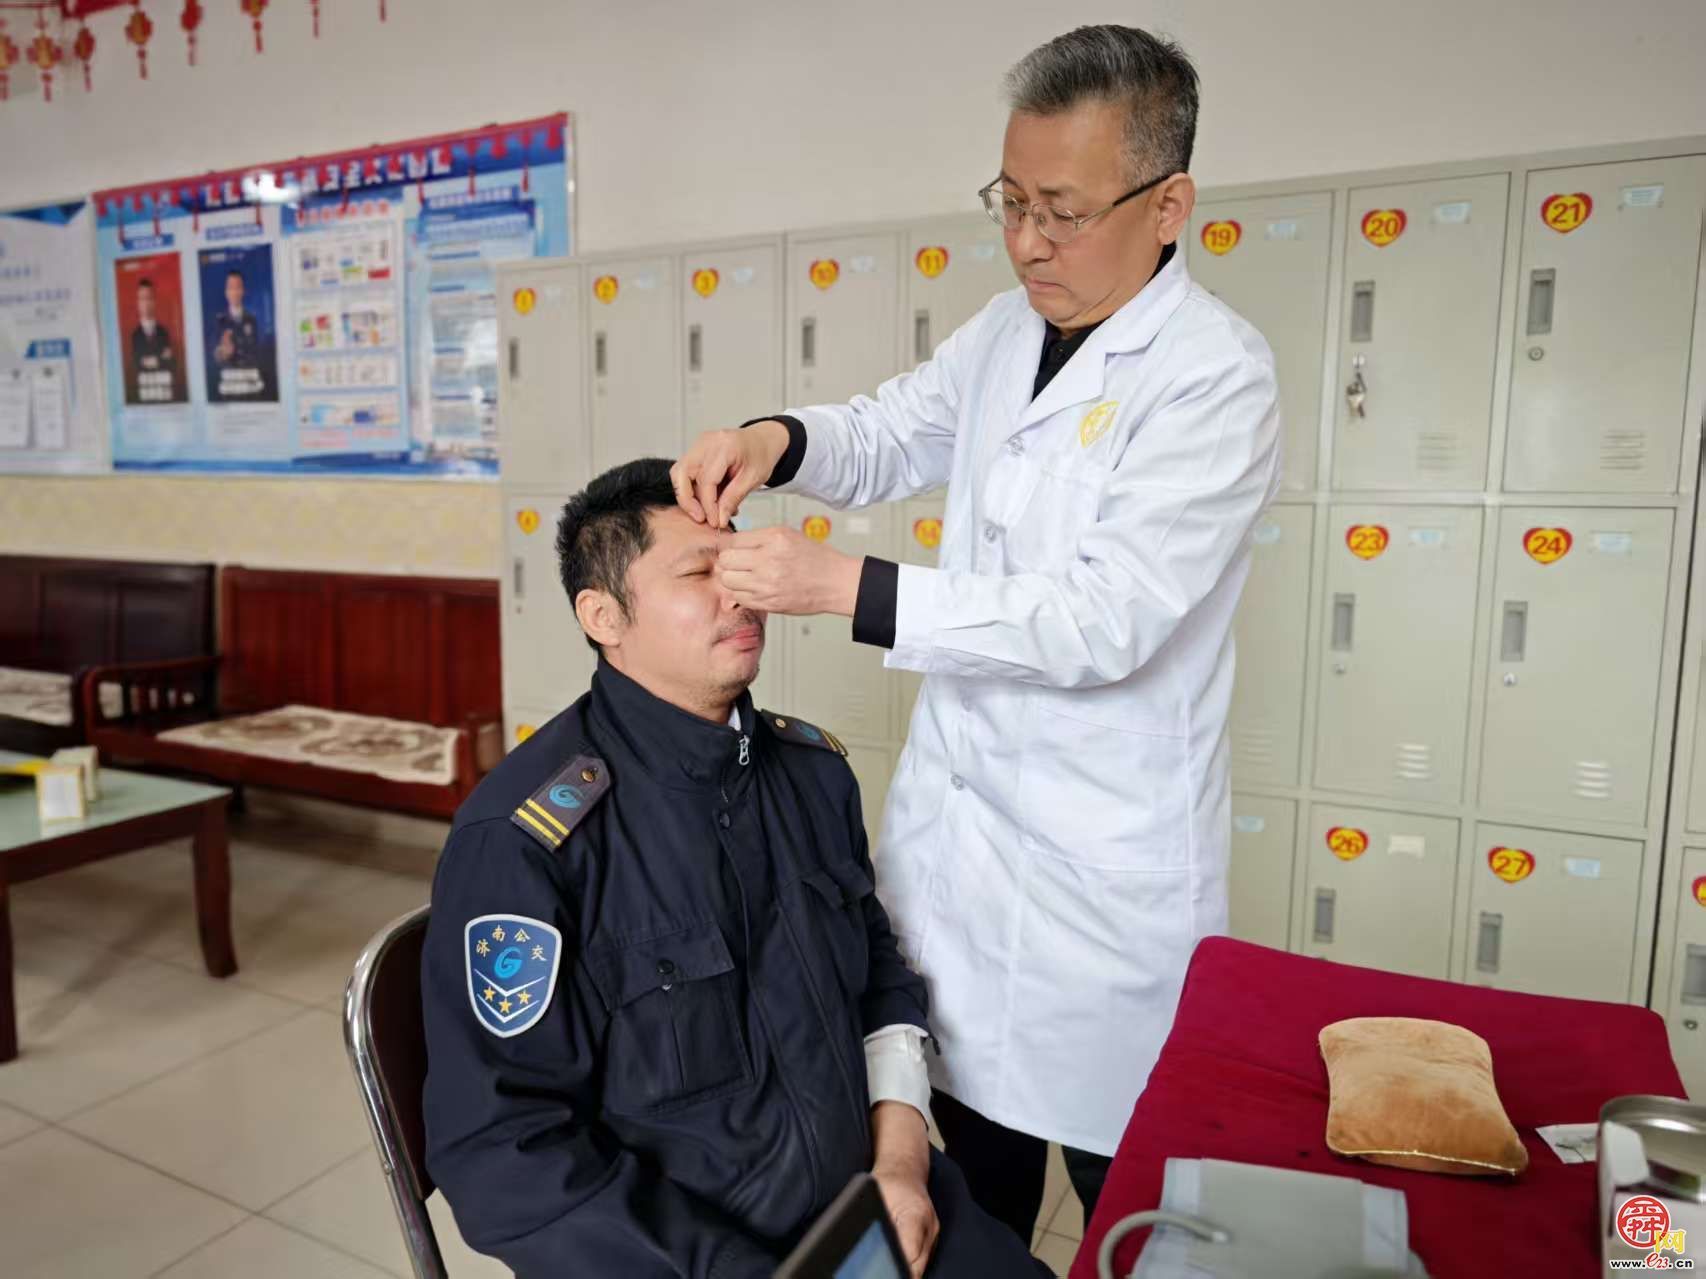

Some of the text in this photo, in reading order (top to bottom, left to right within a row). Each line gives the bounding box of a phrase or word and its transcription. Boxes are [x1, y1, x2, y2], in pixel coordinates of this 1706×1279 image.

[1552, 202, 1581, 223] 21
[1209, 228, 1231, 247] 19
[1369, 217, 1399, 238] 20
[923, 254, 941, 270] 11
[1353, 531, 1381, 551] 23
[1532, 535, 1562, 555] 24
[1332, 834, 1360, 854] 26
[1495, 855, 1528, 875] 27
[476, 924, 547, 961] 济南公交
